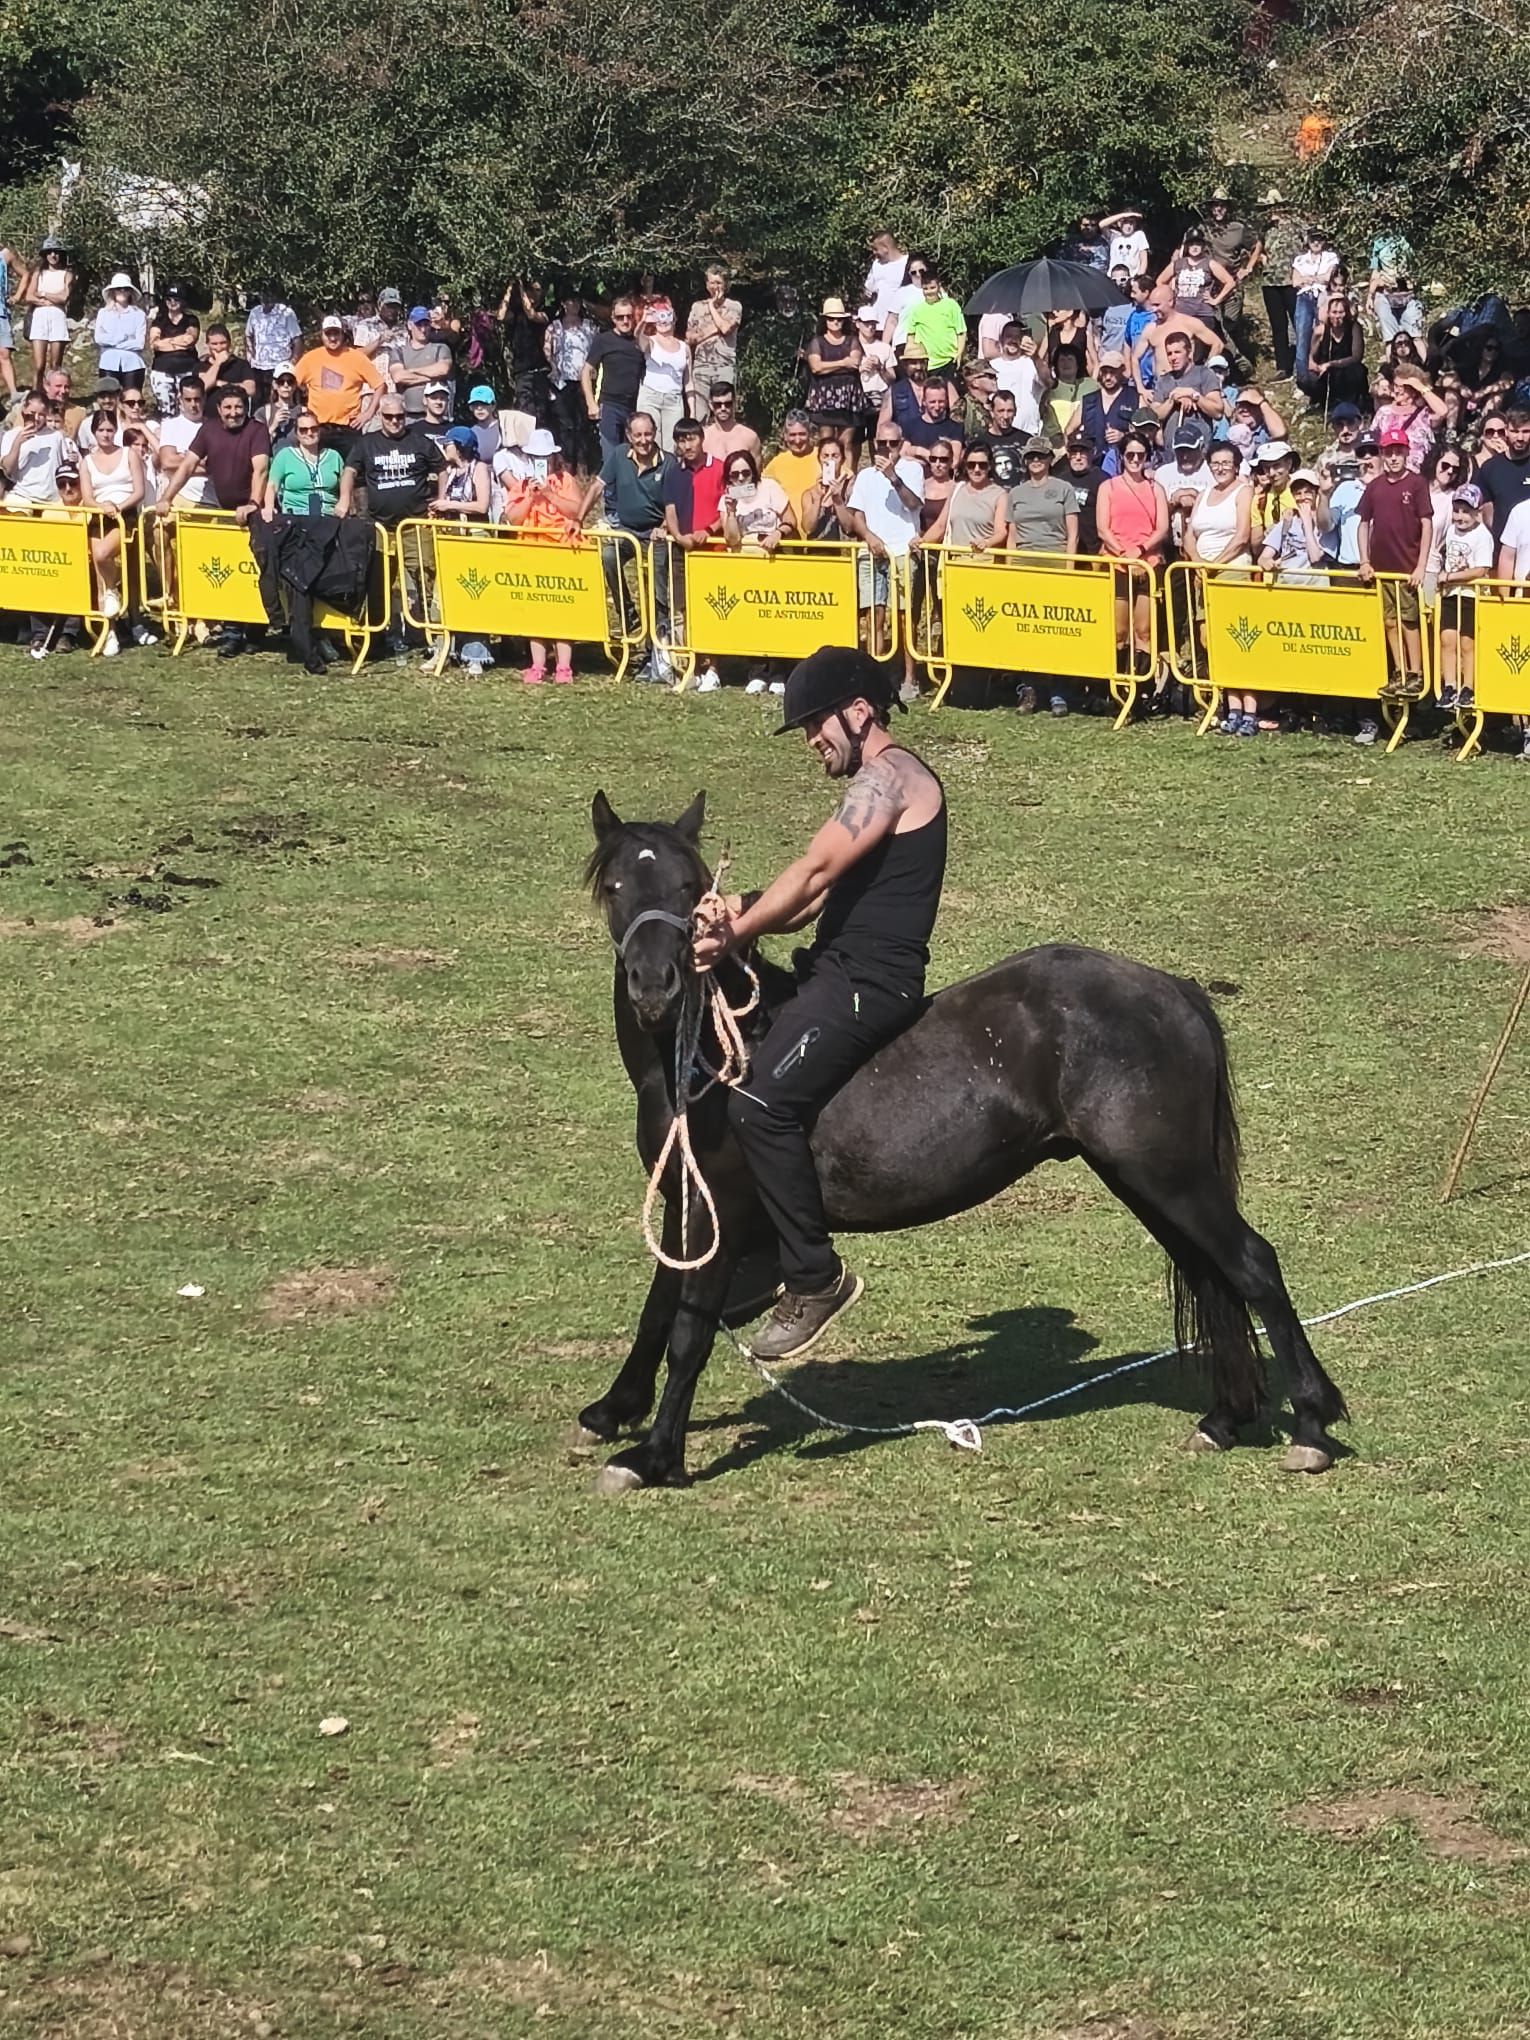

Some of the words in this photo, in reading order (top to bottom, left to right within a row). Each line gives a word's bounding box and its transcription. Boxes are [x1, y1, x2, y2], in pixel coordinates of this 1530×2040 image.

[21, 549, 72, 566] RURAL
[11, 566, 59, 578] ASTURIAS
[238, 561, 259, 575] CA
[494, 571, 532, 588] CAJA
[535, 575, 589, 592] RURAL
[510, 591, 524, 601] DE
[526, 592, 575, 604] ASTURIAS
[743, 589, 781, 605] CAJA
[785, 590, 839, 606] RURAL
[758, 609, 772, 619] DE
[774, 609, 824, 620] ASTURIAS
[1001, 602, 1040, 619] CAJA
[1043, 605, 1097, 624] RURAL
[1016, 623, 1030, 633] DE
[1032, 624, 1082, 637] ASTURIAS
[1266, 620, 1306, 638] CAJA
[1309, 623, 1367, 642] RURAL
[1282, 642, 1297, 653] DE
[1299, 643, 1352, 656] ASTURIAS
